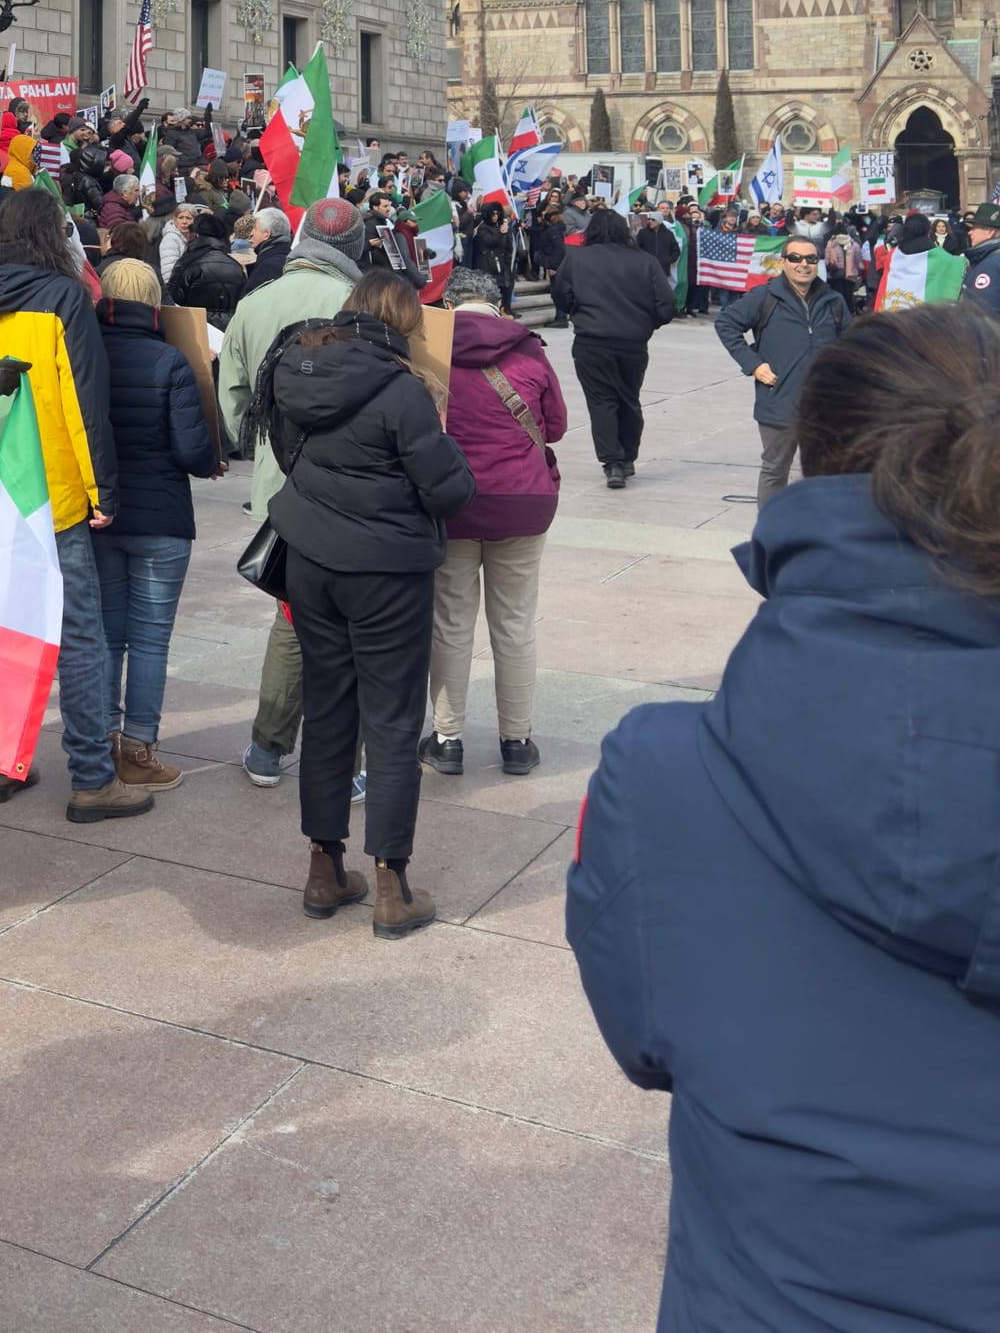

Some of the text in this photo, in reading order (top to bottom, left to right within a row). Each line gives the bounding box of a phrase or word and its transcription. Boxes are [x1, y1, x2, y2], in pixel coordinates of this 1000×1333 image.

[19, 81, 76, 98] PAHLAVI
[861, 153, 894, 167] FREE
[861, 167, 895, 178] IRAN
